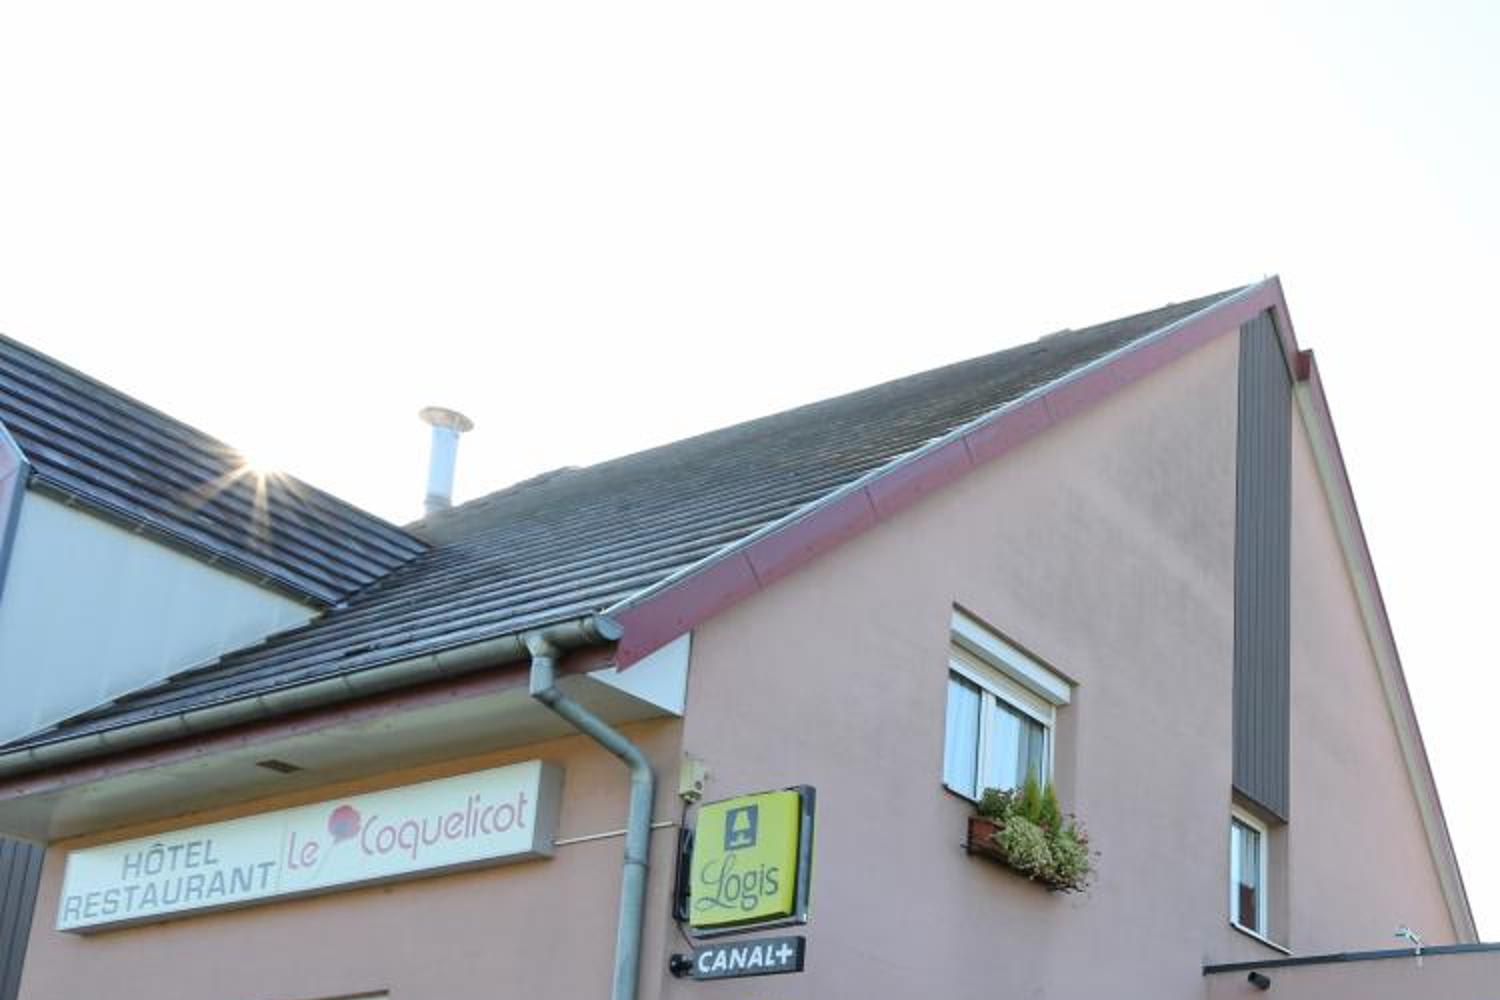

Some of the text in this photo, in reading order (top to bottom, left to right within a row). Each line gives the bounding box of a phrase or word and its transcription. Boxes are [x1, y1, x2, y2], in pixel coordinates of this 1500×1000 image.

[121, 838, 219, 881] HÔTEL
[286, 792, 528, 870] Le Coquelicot
[64, 863, 274, 922] RESTAURANT
[696, 853, 779, 912] Logis
[698, 943, 793, 973] CANAL+
